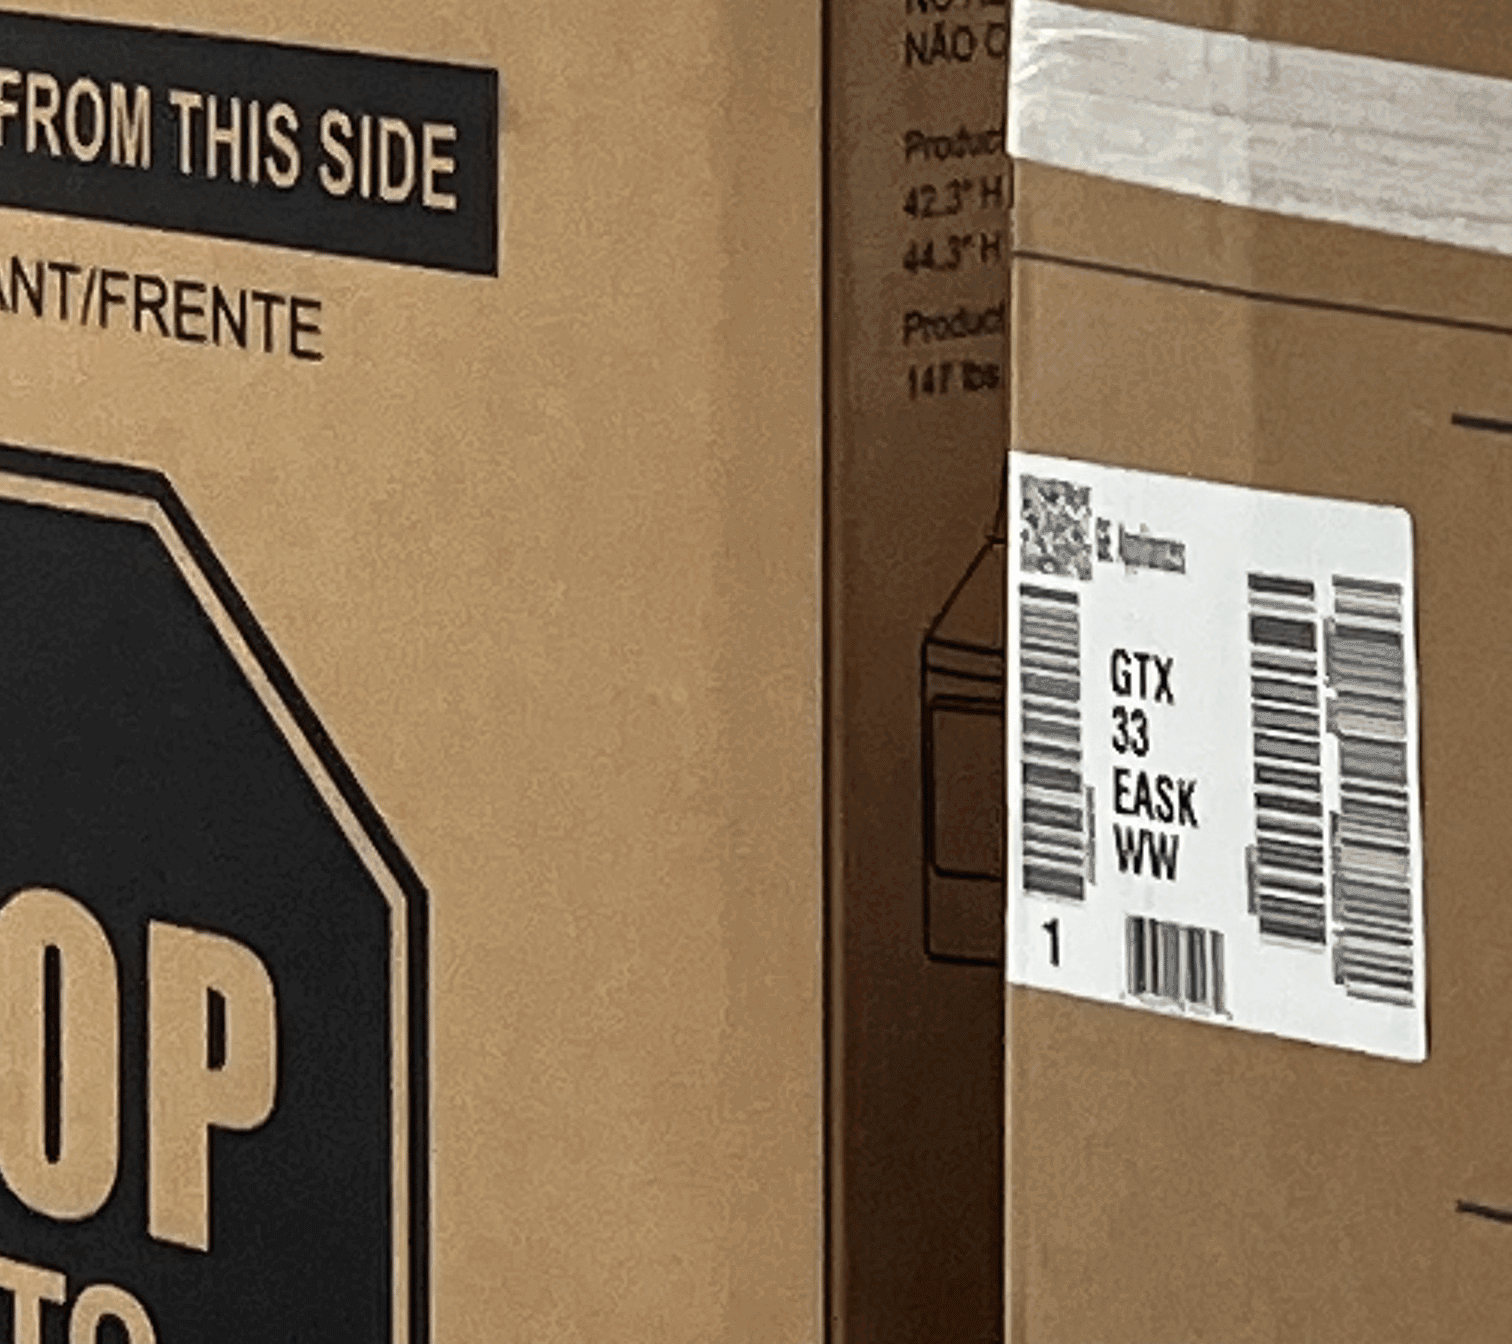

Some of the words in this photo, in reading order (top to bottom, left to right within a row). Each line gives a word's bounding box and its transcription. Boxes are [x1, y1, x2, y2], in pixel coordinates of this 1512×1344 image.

[168, 89, 302, 188] THIS
[318, 109, 458, 210] SIDE
[1109, 647, 1175, 706] GTX
[1111, 705, 1150, 758] 33
[1113, 765, 1199, 830] EASK
[1112, 822, 1180, 883] WW
[1043, 918, 1061, 966] 1
